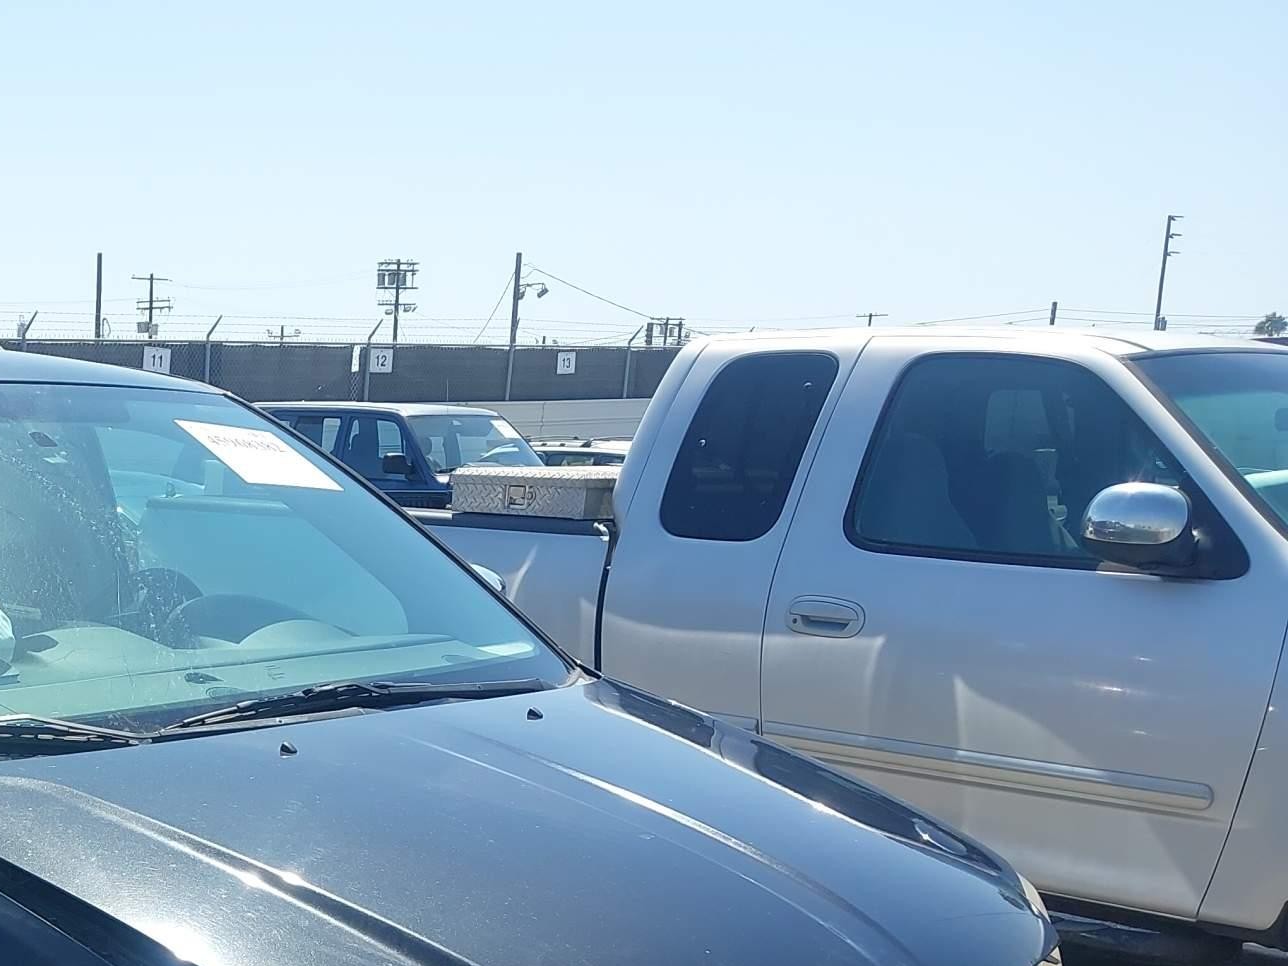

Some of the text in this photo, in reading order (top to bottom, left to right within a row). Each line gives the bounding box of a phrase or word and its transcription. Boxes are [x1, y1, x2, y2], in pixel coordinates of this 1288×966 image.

[152, 353, 163, 368] 11
[376, 354, 387, 367] 12
[562, 357, 571, 369] 13
